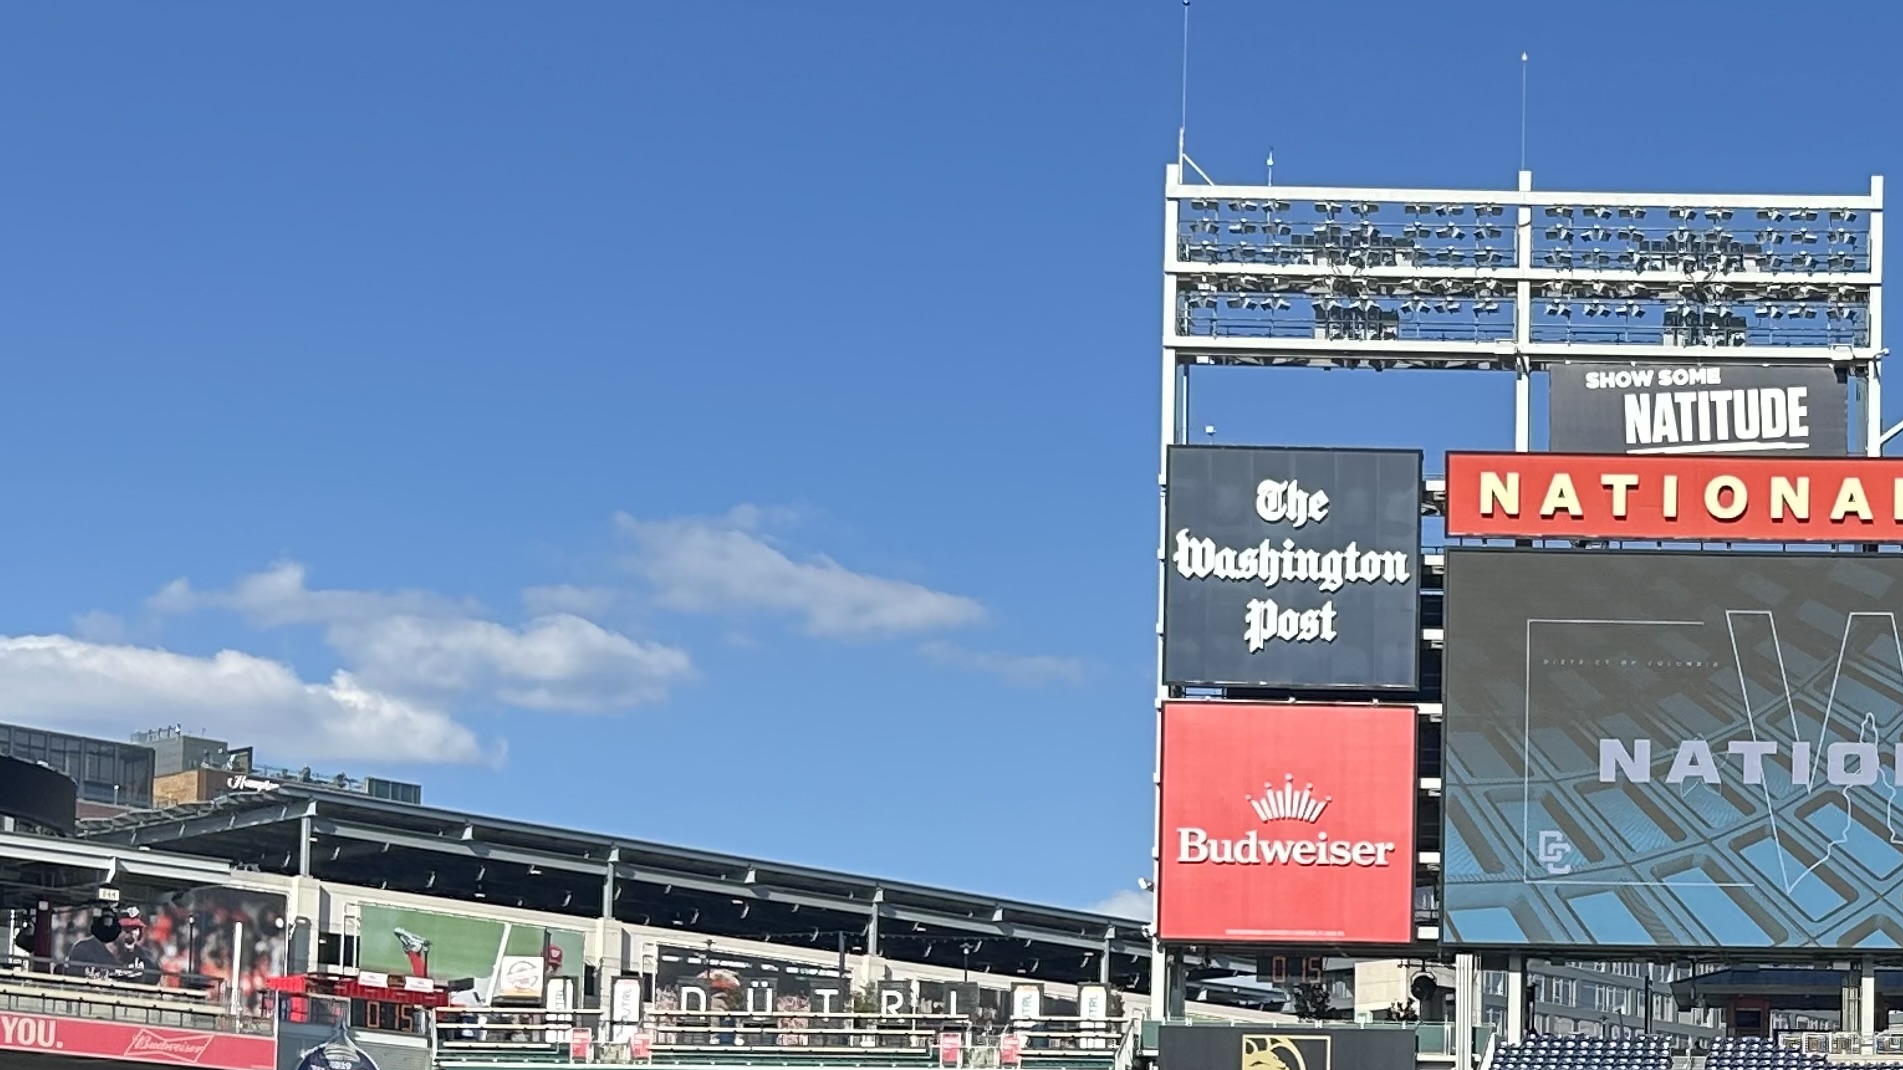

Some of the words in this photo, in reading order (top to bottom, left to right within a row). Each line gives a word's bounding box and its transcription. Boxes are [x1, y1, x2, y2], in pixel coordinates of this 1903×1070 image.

[1585, 370, 1654, 389] SHOW
[1658, 367, 1722, 386] SOME
[1624, 386, 1809, 445] NATITUDE
[1255, 478, 1330, 528] The
[1174, 530, 1410, 592] Washington
[1244, 600, 1338, 652] Post
[1176, 827, 1395, 868] Budweiser
[1, 1016, 64, 1049] YOU.
